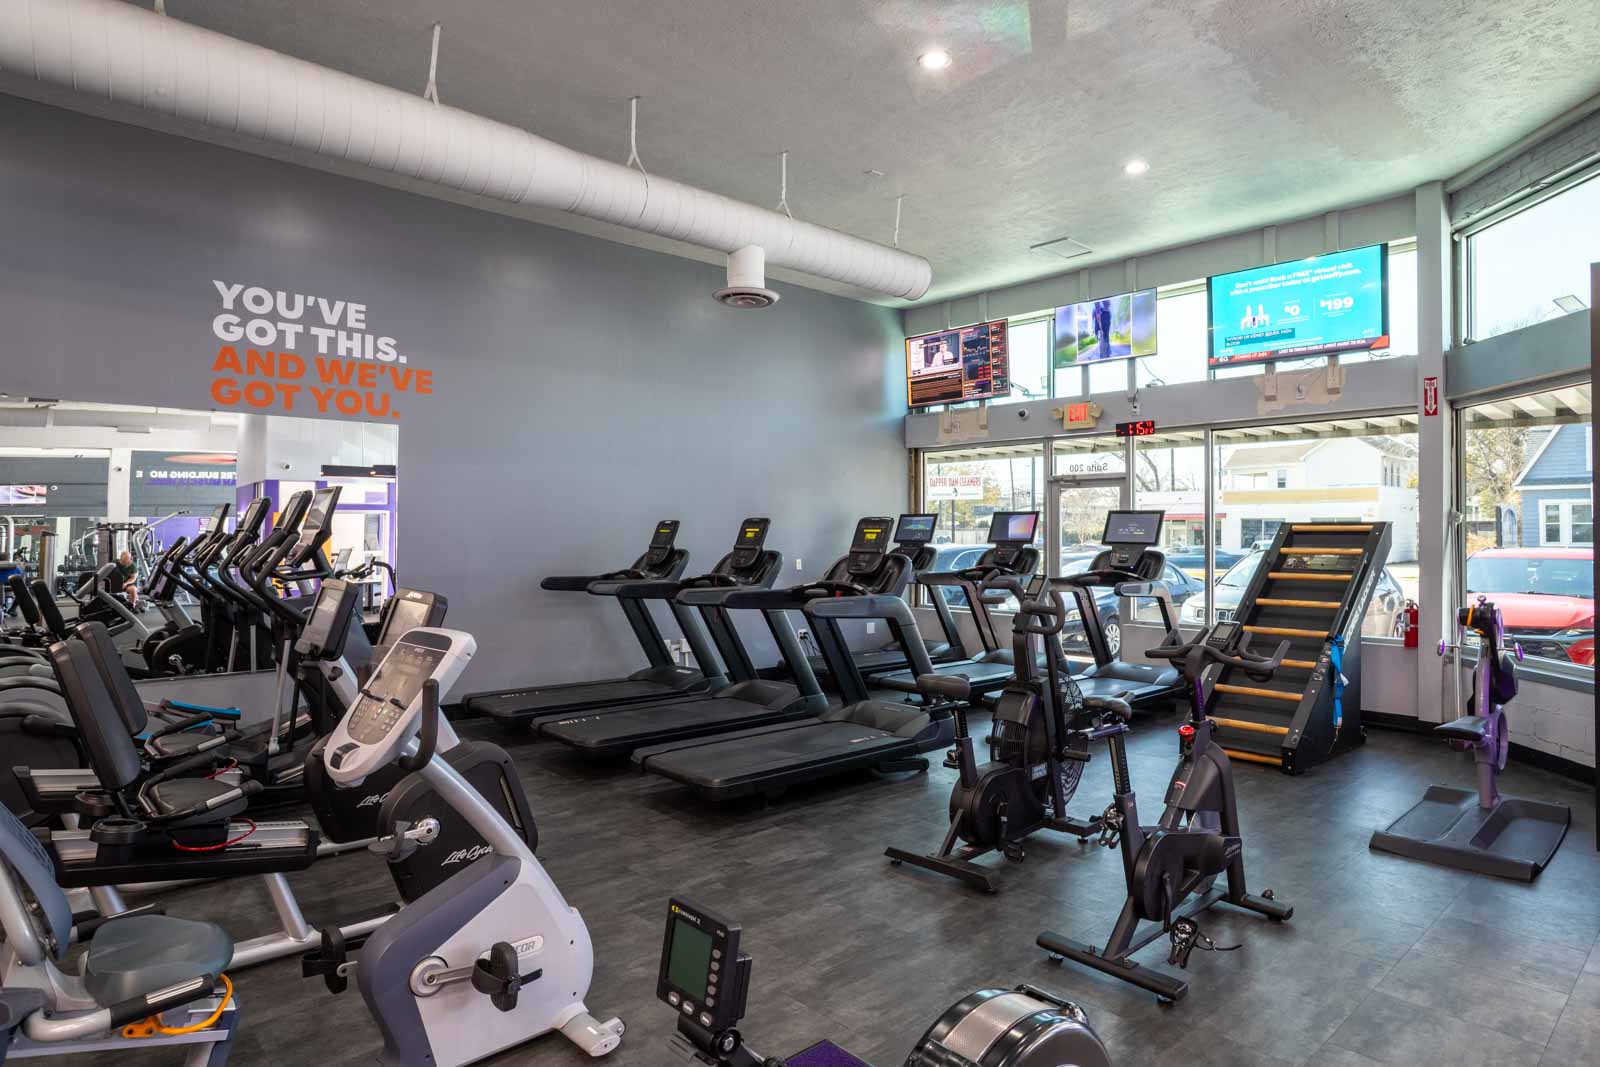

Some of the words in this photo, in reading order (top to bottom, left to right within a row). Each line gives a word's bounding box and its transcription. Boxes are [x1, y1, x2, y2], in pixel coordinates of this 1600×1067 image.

[212, 279, 367, 330] YOU'VE
[212, 313, 303, 350] GOT
[310, 327, 408, 364] THIS.
[211, 345, 306, 379] AND
[314, 357, 433, 395] WE'VE
[210, 377, 302, 412] GOT
[309, 387, 400, 419] YOU.
[1069, 404, 1089, 422] EXIT
